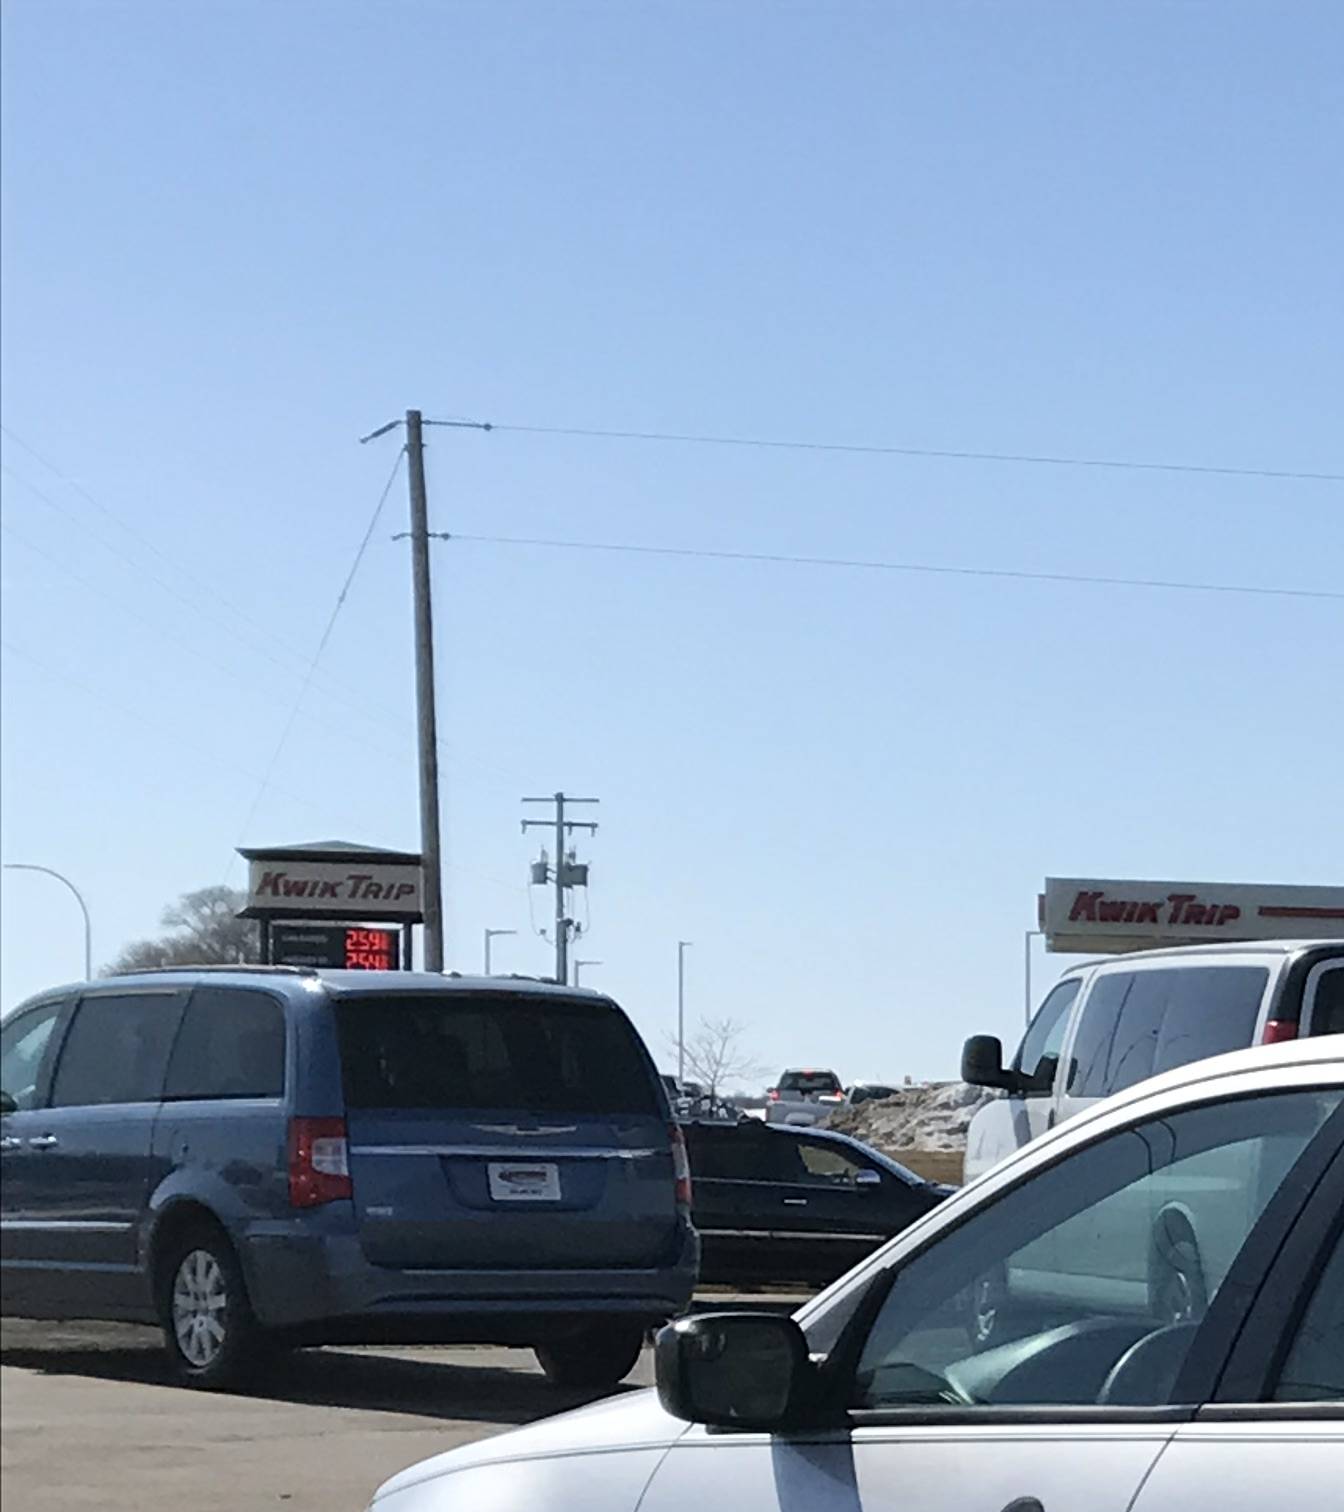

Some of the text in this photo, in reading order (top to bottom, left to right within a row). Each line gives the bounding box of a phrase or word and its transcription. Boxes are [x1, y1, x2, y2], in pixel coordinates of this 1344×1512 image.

[255, 871, 416, 901] KWIK TRIP
[1068, 891, 1241, 926] KWIK TRIP
